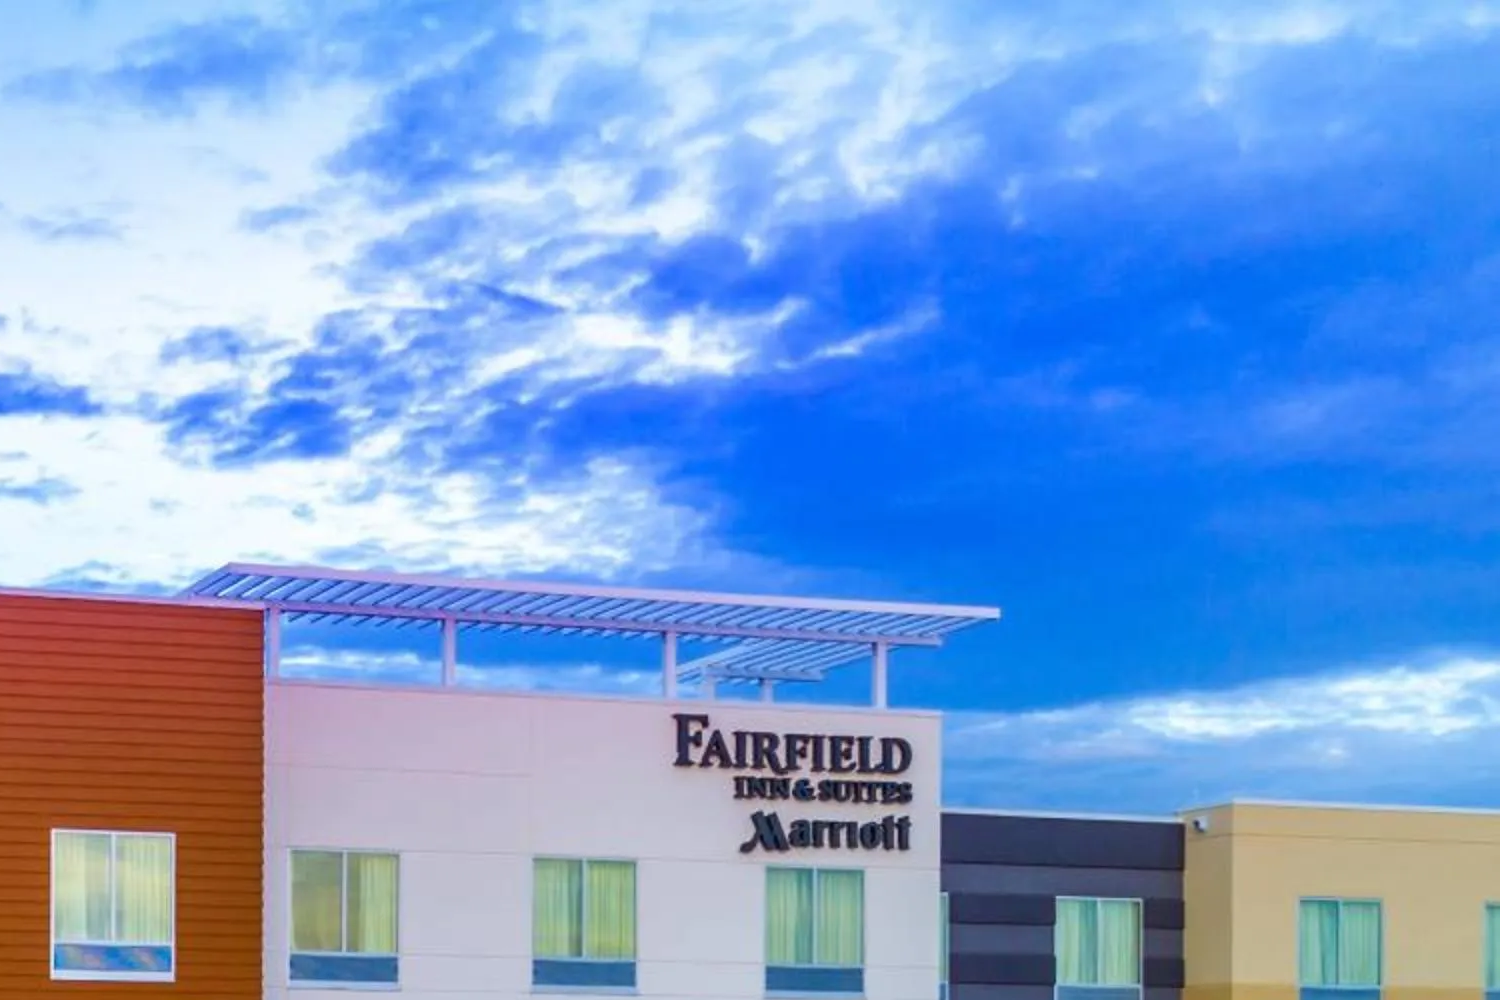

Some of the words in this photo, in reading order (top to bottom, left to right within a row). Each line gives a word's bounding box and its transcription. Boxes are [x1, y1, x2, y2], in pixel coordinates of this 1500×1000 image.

[672, 713, 913, 775] FAIRFIELD
[733, 775, 791, 800] INN
[817, 779, 913, 804] SUITES
[739, 810, 912, 853] Marriott
